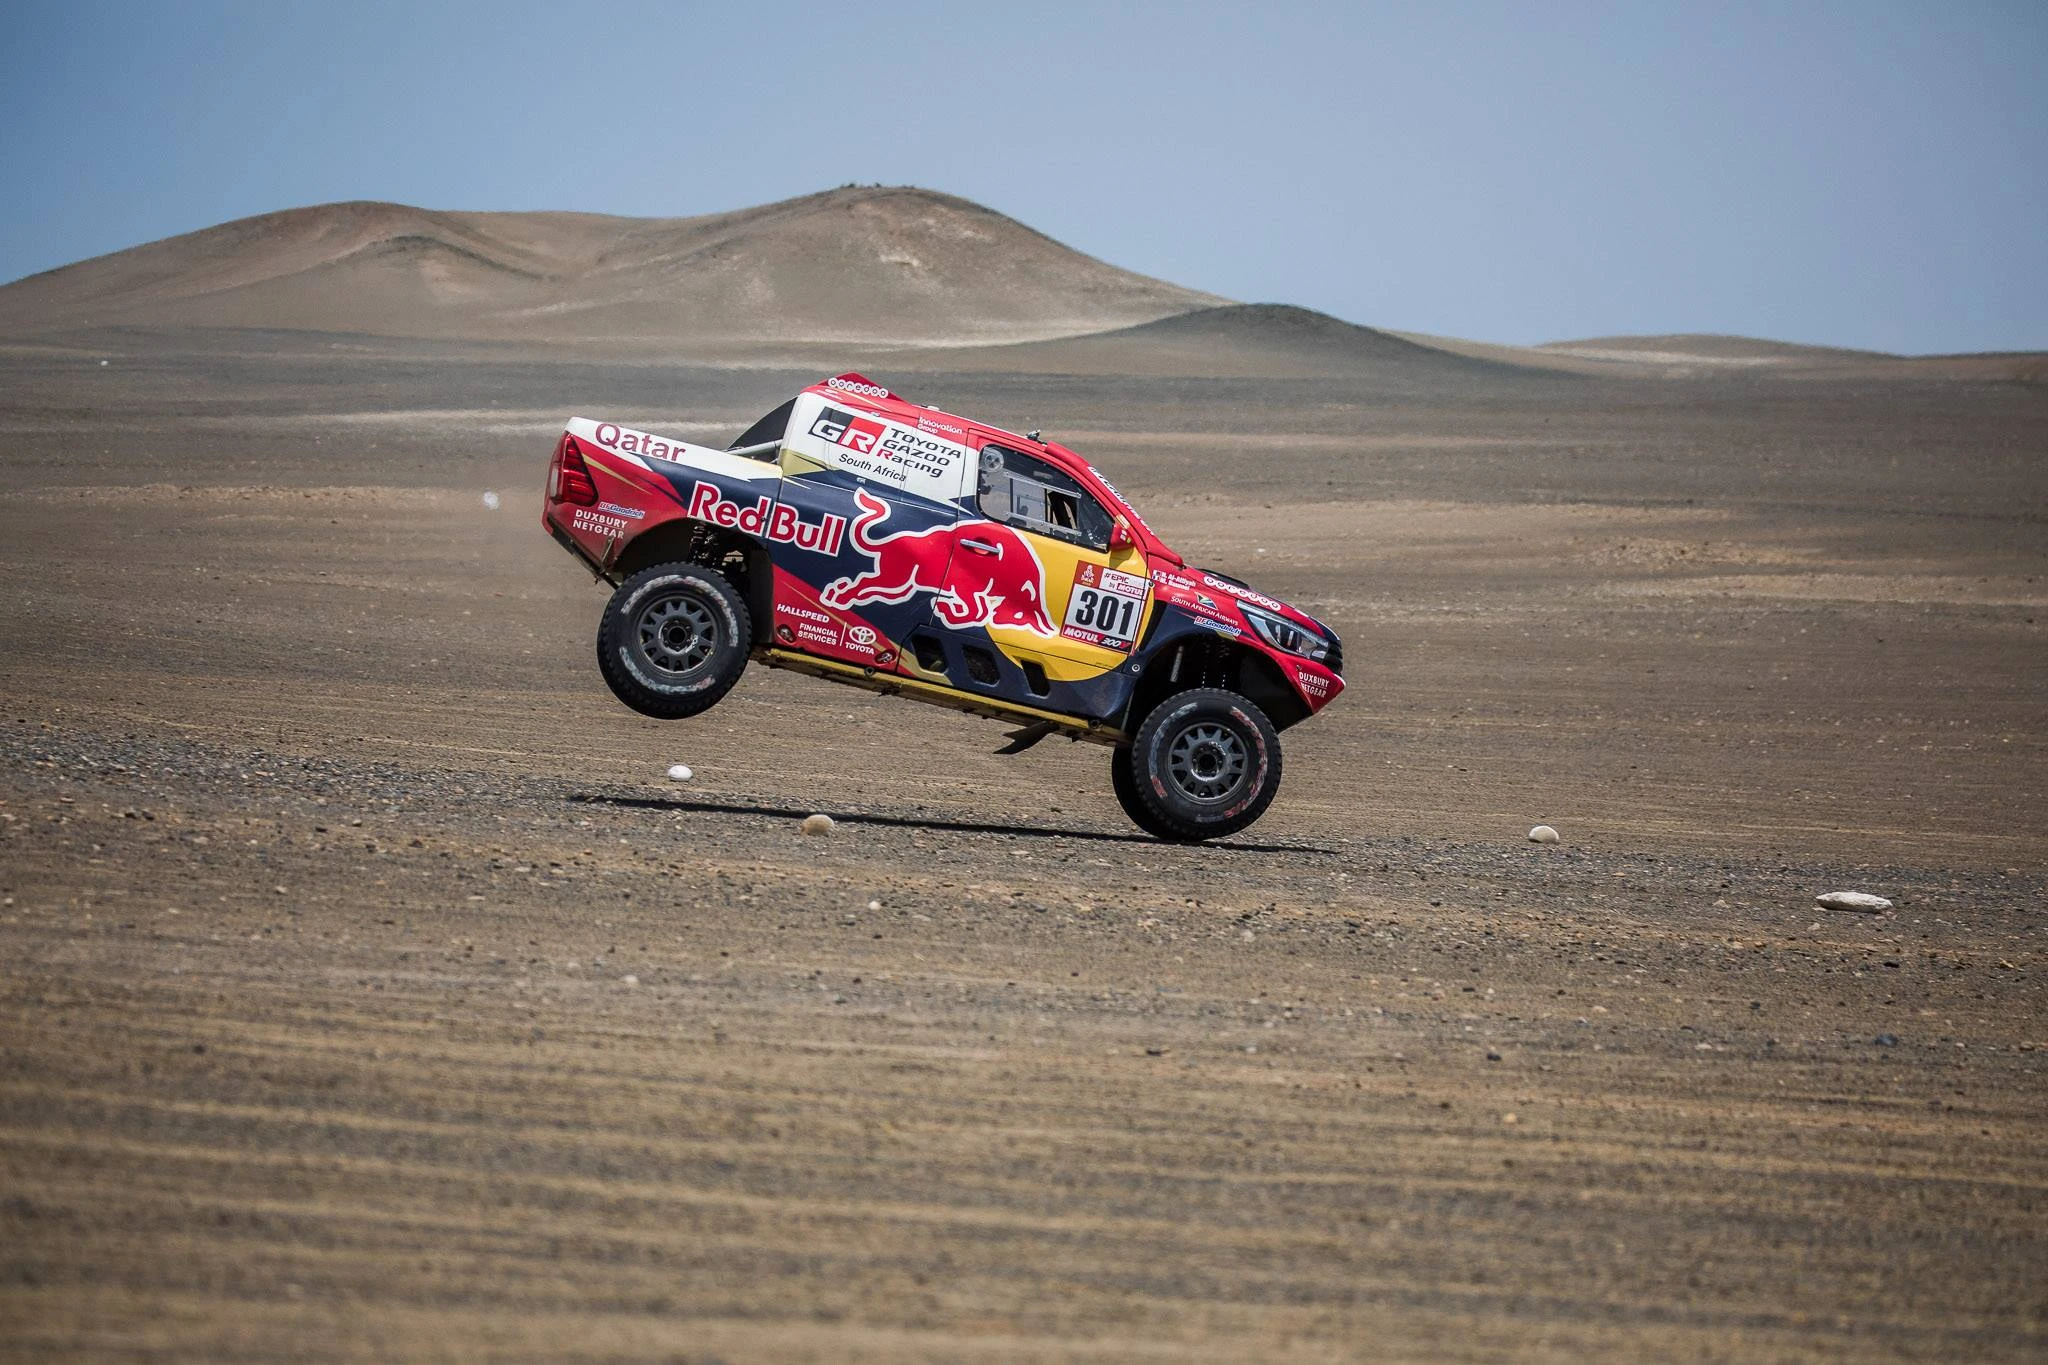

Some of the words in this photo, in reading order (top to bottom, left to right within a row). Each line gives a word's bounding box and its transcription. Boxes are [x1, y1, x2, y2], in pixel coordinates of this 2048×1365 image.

[829, 378, 888, 398] ooredoo
[809, 417, 878, 455] GR
[917, 424, 939, 434] Group
[919, 417, 963, 435] Innovation
[595, 423, 686, 462] Qatar
[890, 428, 961, 459] TOYOTA
[883, 439, 950, 467] GAZOO
[838, 453, 872, 471] South
[873, 464, 906, 482] Africa
[876, 449, 943, 478] Racing
[575, 509, 628, 529] DUXBURY
[687, 480, 772, 537] Red
[765, 501, 847, 558] Bull
[573, 520, 624, 539] NETGEAR
[776, 603, 830, 623] HALLSPEED
[1075, 590, 1134, 637] 301
[1171, 596, 1191, 607] SOUTH
[1190, 602, 1216, 617] AFRICAN
[1216, 611, 1239, 627] AIRWAYS
[797, 631, 837, 646] SERVICES
[799, 622, 838, 638] FINANCIAL
[1064, 627, 1099, 643] MOTUL
[845, 642, 875, 655] TOYOTA
[1298, 671, 1330, 688] DUXBURY
